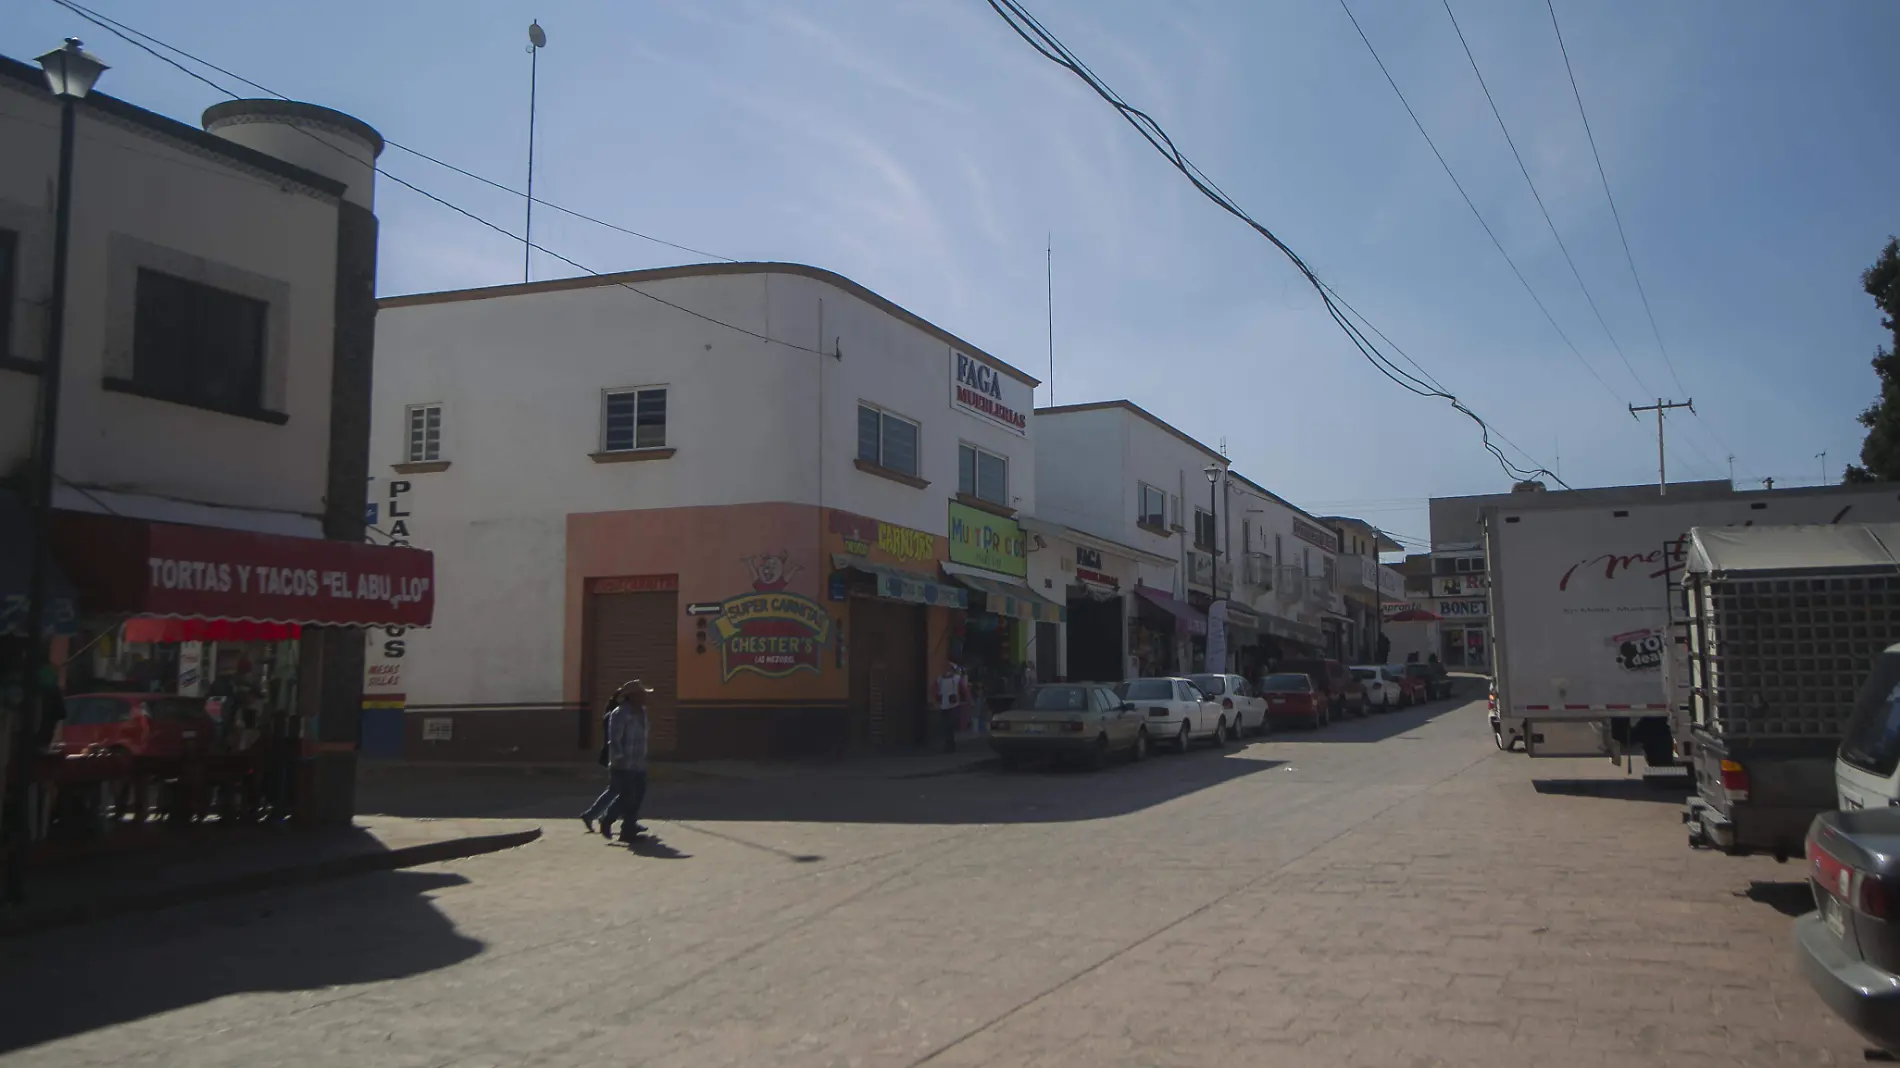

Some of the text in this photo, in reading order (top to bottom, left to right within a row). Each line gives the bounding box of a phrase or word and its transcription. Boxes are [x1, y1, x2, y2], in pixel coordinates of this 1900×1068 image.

[956, 385, 1026, 429] MUEBLERIAS
[878, 522, 934, 562] CARNITAS
[149, 557, 232, 593] TORTAS
[236, 564, 252, 593] Y
[256, 566, 319, 597] TACOS
[384, 481, 411, 658] PLAOS
[728, 599, 768, 619] SUPER
[731, 636, 813, 654] CHESTER'S
[1630, 636, 1661, 653] TO
